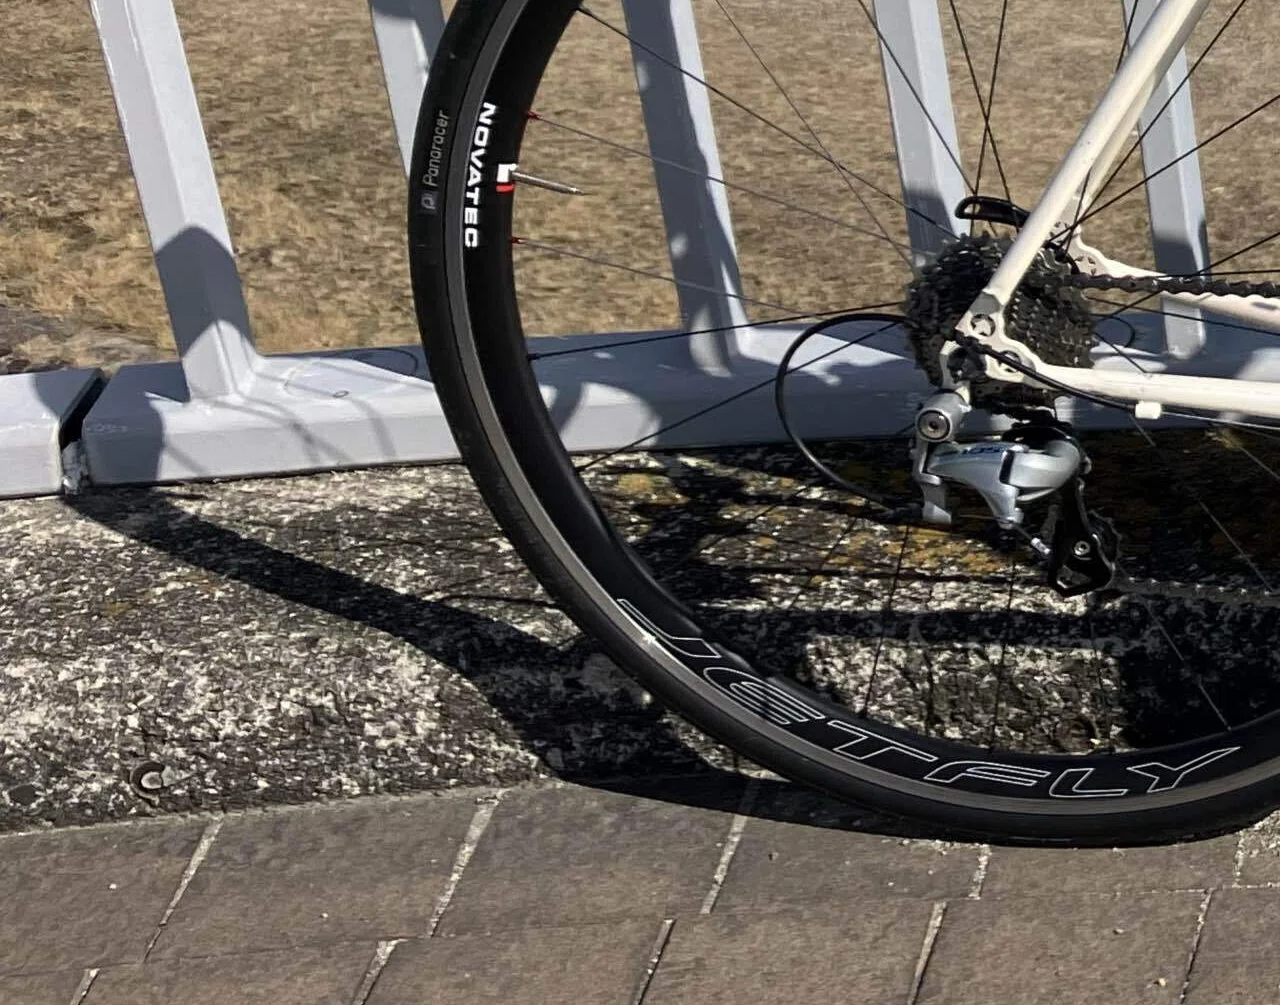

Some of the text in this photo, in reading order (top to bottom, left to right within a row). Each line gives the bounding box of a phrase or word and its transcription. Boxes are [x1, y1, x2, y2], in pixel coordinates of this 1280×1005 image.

[422, 109, 450, 188] Panaracer
[464, 101, 498, 248] NOVATEC
[616, 598, 1241, 798] JETFLY
